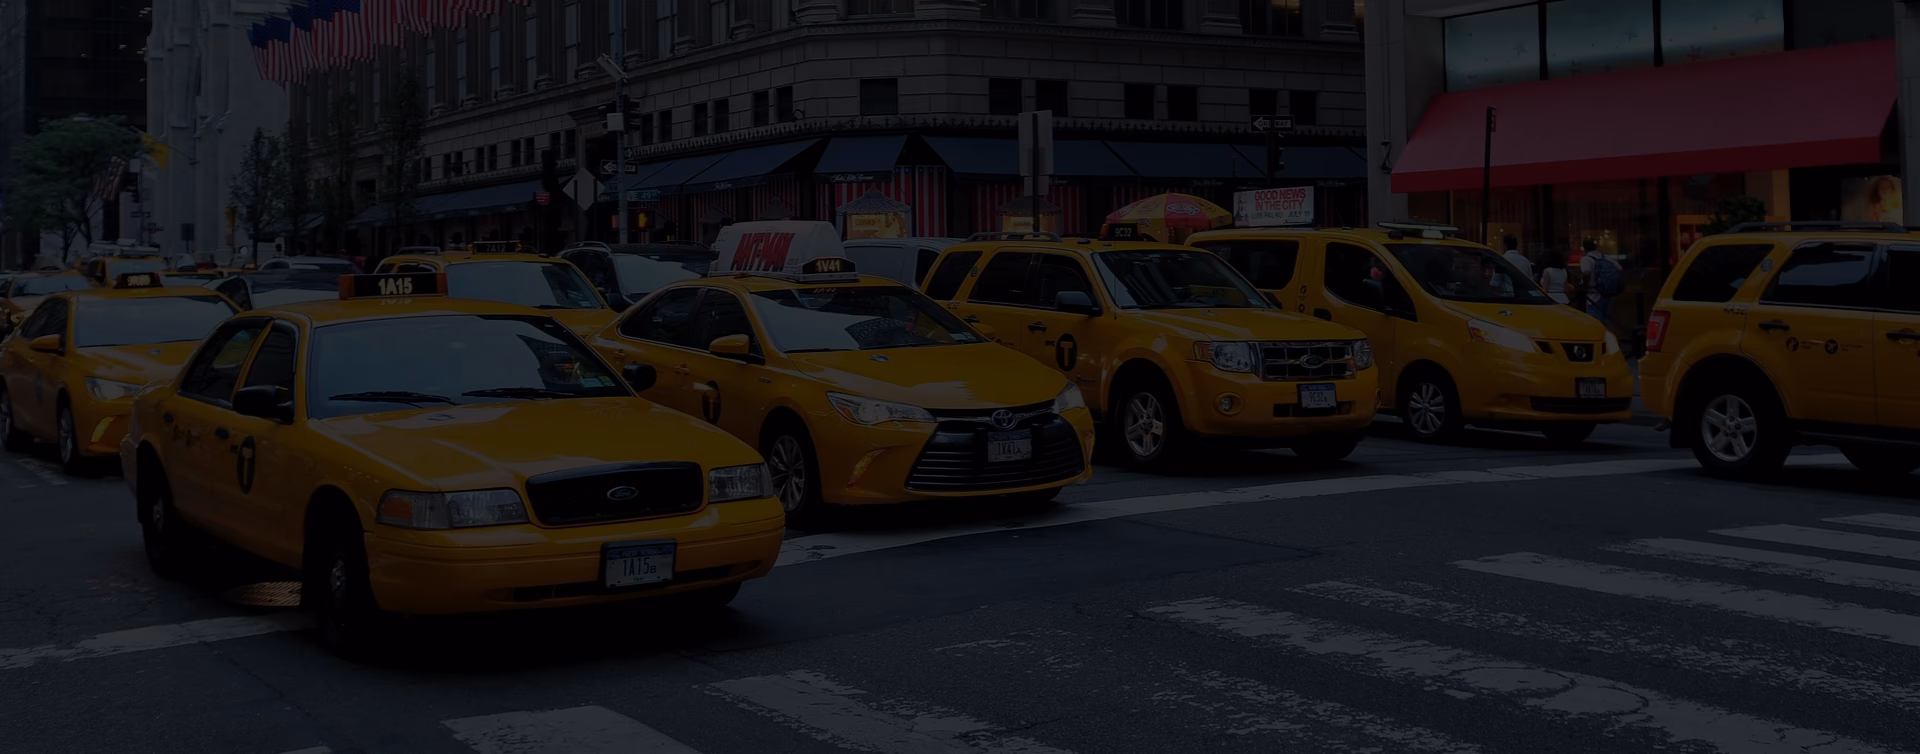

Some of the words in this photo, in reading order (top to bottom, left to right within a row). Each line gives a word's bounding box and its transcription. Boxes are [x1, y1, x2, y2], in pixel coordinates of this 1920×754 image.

[1259, 119, 1271, 128] ONE
[1274, 119, 1289, 128] WAY
[641, 191, 651, 200] 49
[1254, 190, 1278, 201] GOOD
[1280, 188, 1306, 200] NEWS
[1255, 201, 1263, 211] IN
[1264, 200, 1282, 211] THE
[1282, 199, 1305, 210] CITY
[1114, 227, 1132, 237] 9C32
[485, 243, 506, 253] 7A12
[730, 232, 796, 272] ANT-MAN
[815, 259, 841, 272] 1V41
[378, 277, 413, 296] 1A15
[1060, 341, 1073, 367] T
[242, 447, 253, 486] T
